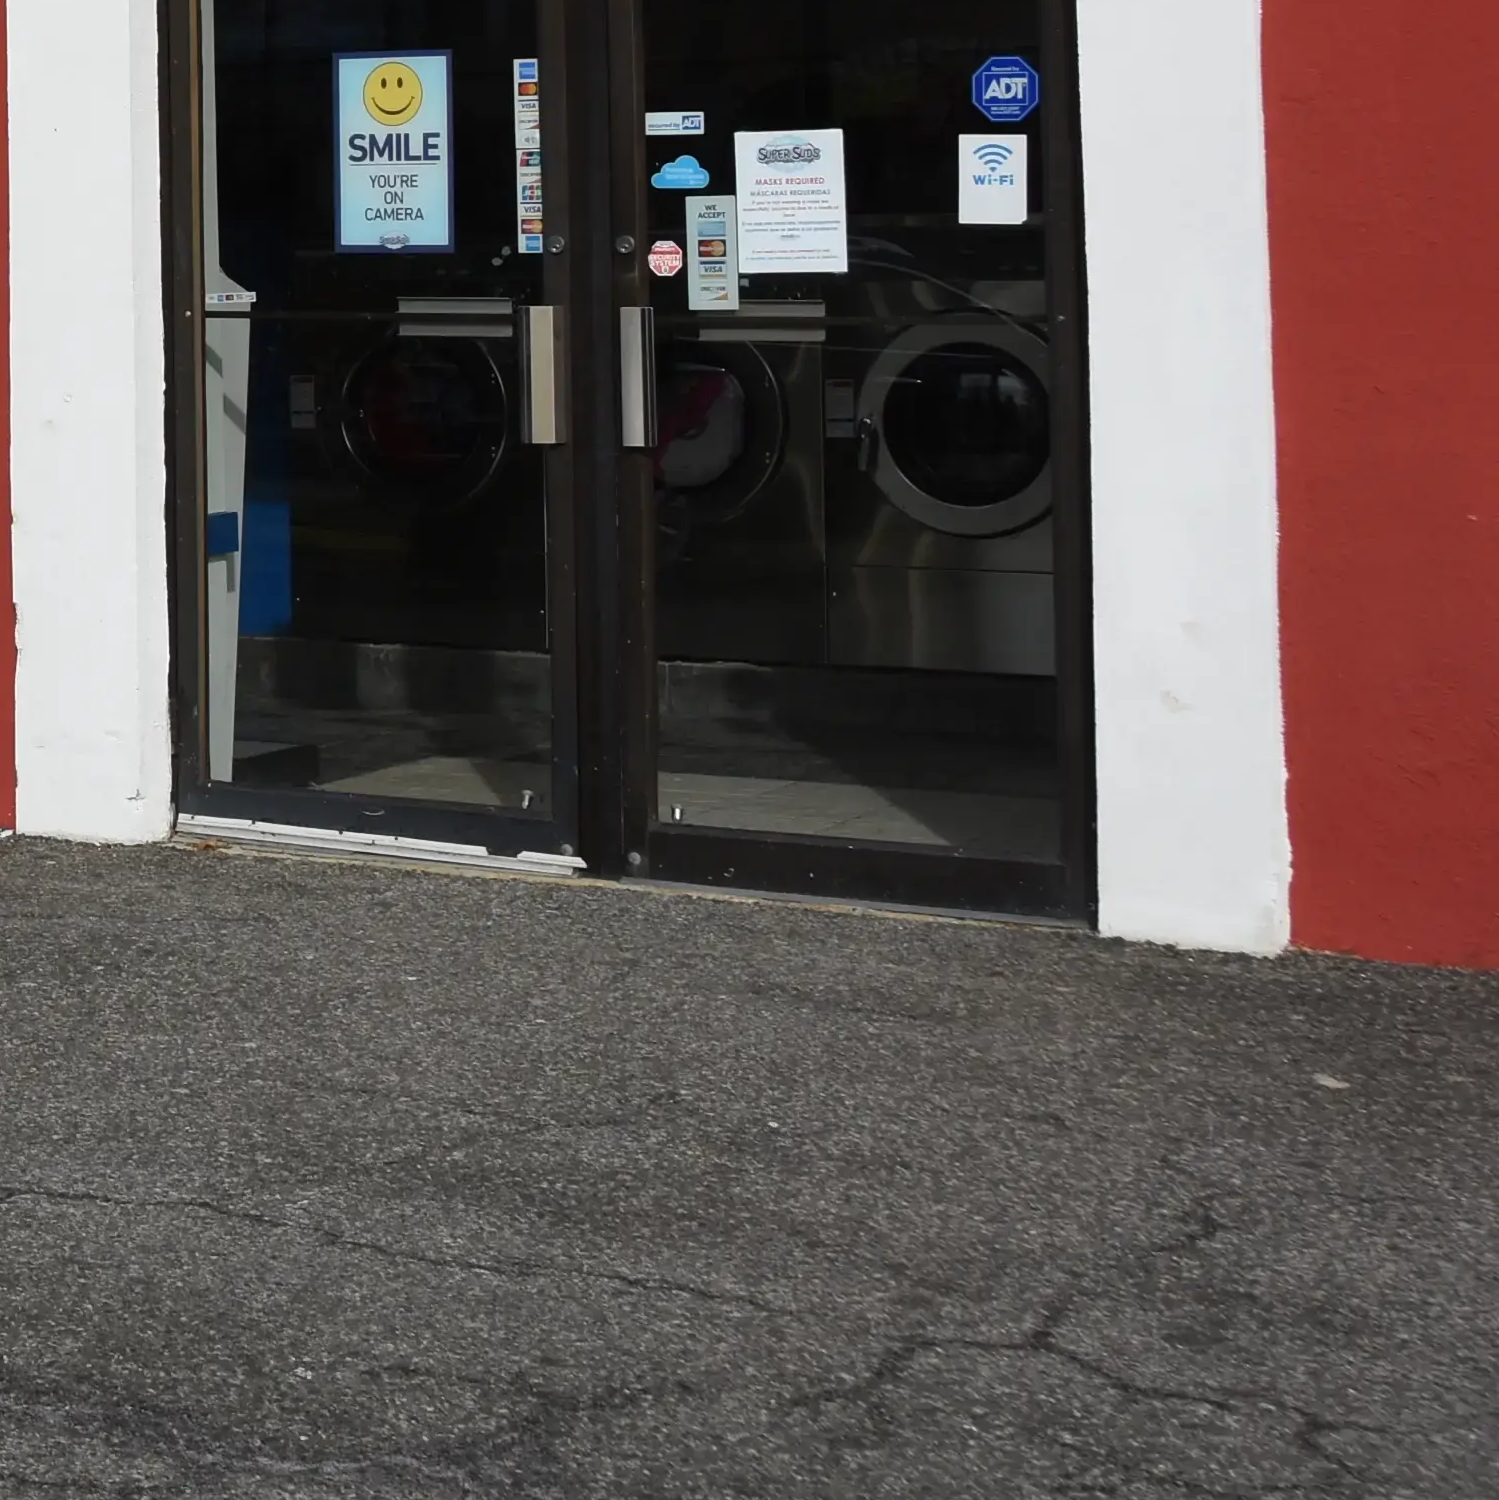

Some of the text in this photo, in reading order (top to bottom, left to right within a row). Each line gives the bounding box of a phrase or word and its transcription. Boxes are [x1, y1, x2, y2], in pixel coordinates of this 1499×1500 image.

[984, 77, 1028, 99] ADT
[683, 117, 701, 129] ADT
[348, 132, 441, 162] SMILE
[369, 174, 419, 188] YOU'RE
[785, 177, 825, 185] REQUIRED
[972, 174, 1014, 185] Wi-Fi
[383, 191, 404, 204] ON
[364, 207, 424, 221] CAMERA
[523, 205, 541, 213] VISA
